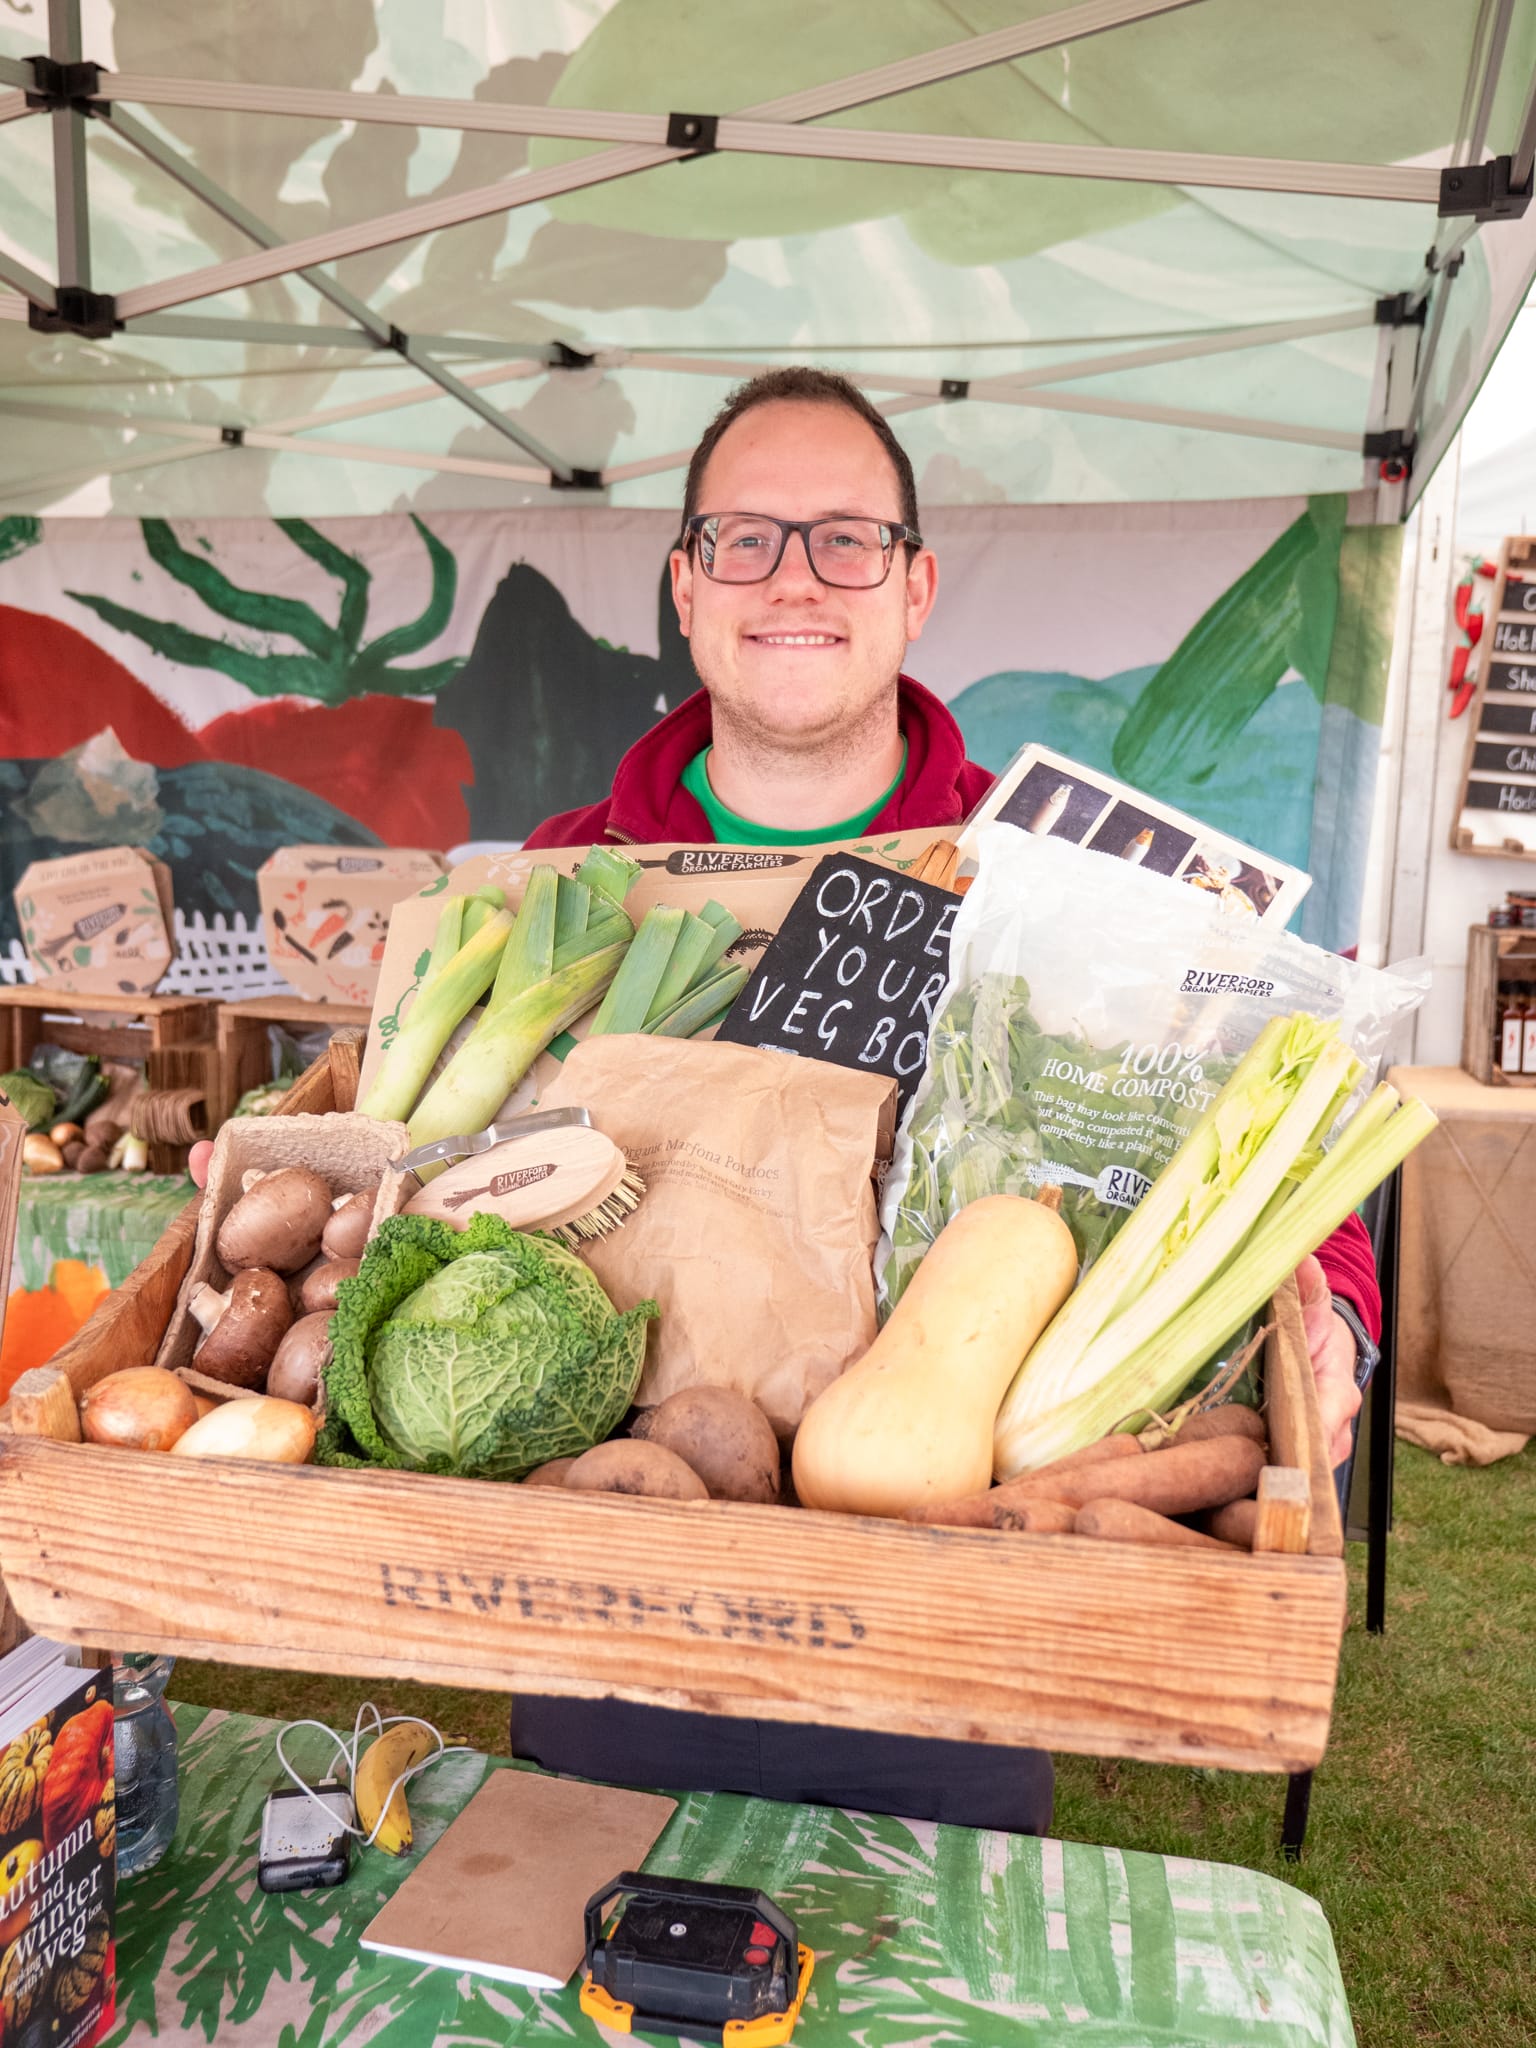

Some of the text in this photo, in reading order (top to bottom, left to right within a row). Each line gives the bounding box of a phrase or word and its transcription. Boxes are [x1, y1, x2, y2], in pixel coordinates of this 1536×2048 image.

[681, 861, 782, 873] ORGANIC FARMERS
[682, 852, 784, 866] RIVERFORD
[816, 869, 962, 957] ORDE
[803, 927, 946, 1024] YOUR
[1180, 984, 1272, 998] ORGANIC FARMERS
[1182, 969, 1275, 991] RIVERFORD
[749, 976, 853, 1051] VEG
[857, 1016, 928, 1076] BO
[1117, 1042, 1209, 1082] 100%
[1034, 1090, 1054, 1104] This
[1055, 1094, 1076, 1113] bag
[1077, 1103, 1100, 1119] may
[1102, 1110, 1125, 1122] look
[1127, 1110, 1143, 1122] like
[1041, 1058, 1217, 1113] HOME COMPOST
[1055, 1109, 1084, 1128] when
[1087, 1123, 1143, 1139] composted
[1145, 1127, 1154, 1139] it
[1156, 1133, 1173, 1148] will
[1098, 1138, 1116, 1149] like
[1117, 1141, 1124, 1149] a
[1125, 1140, 1153, 1155] plant
[497, 1165, 548, 1187] RIVERFORD
[620, 1142, 662, 1160] Organic
[665, 1138, 721, 1164] Marfona
[724, 1155, 780, 1180] Potatoes
[15, 1864, 102, 1965] winter
[30, 1867, 65, 1922] and
[43, 1908, 86, 1969] veg
